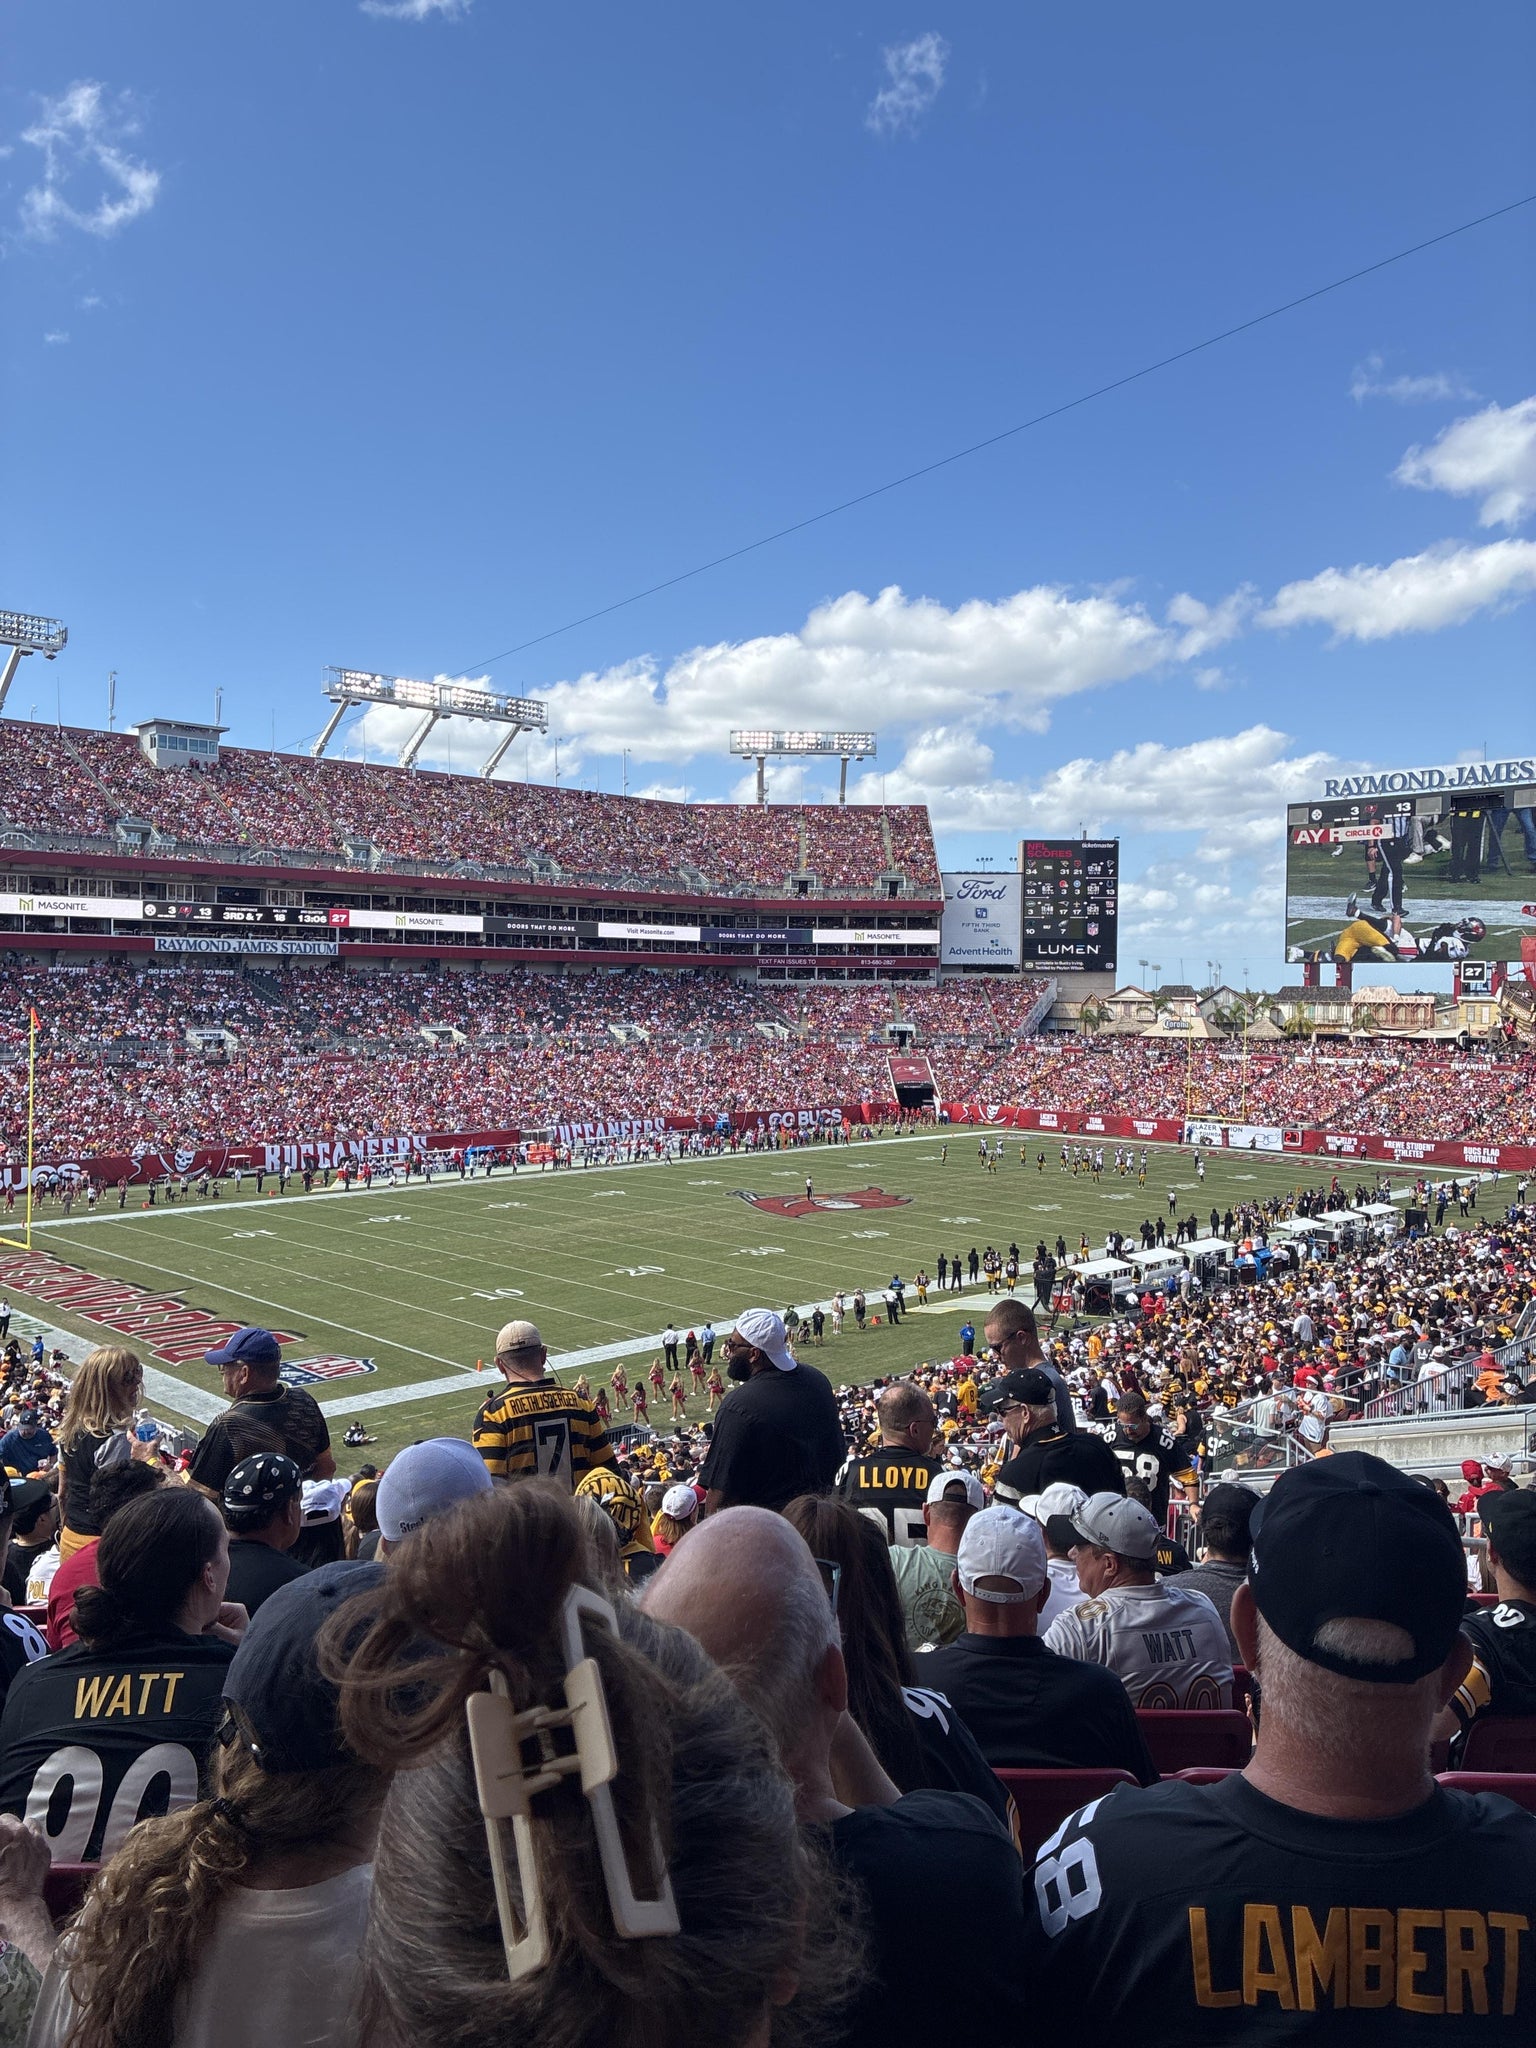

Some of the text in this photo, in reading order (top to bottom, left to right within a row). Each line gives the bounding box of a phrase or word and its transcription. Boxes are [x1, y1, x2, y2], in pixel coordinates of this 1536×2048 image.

[1324, 760, 1535, 797] RAYMOND JAMES
[1350, 806, 1360, 816] 3
[1396, 802, 1411, 812] 13
[1345, 829, 1371, 837] CIRCLE
[1027, 850, 1072, 858] SCORES
[957, 879, 1007, 900] Ford
[38, 900, 88, 912] MASONITE
[168, 906, 176, 914] 3
[199, 908, 212, 916] 13
[222, 912, 263, 921] 3RD & 7
[274, 914, 285, 922] 18
[298, 914, 327, 923] 13:06
[332, 914, 346, 922] 27
[408, 917, 443, 926] MASONITE
[627, 927, 675, 936] Visit Masonite.com
[158, 938, 338, 954] RAYMOND JAMES STADIUM
[948, 946, 1012, 956] AdventHealth
[1038, 944, 1099, 954] LUMEN
[1465, 968, 1482, 976] 27
[769, 1108, 842, 1127] GO BUCS
[1191, 1123, 1217, 1131] GLAZER
[1285, 1132, 1299, 1142] 27
[1384, 1140, 1435, 1152] KREWE STUDENT
[1394, 1148, 1424, 1158] ATHLETES
[1464, 1146, 1500, 1157] BUCS FLAG
[1464, 1154, 1498, 1164] FOOTBALL
[233, 1229, 278, 1238] 10
[740, 1246, 785, 1255] 30
[616, 1265, 666, 1278] 20
[470, 1288, 524, 1302] 10
[303, 1354, 366, 1379] NFL
[945, 1392, 951, 1403] 7
[969, 1390, 975, 1402] 8
[510, 1393, 578, 1416] ROETHLISBERGER
[536, 1420, 567, 1477] 7
[859, 1466, 928, 1490] LLOYD
[915, 1582, 938, 1596] KING
[1142, 1629, 1197, 1664] WATT
[74, 1672, 185, 1719] WATT
[1189, 1904, 1530, 2015] LAMBERT
